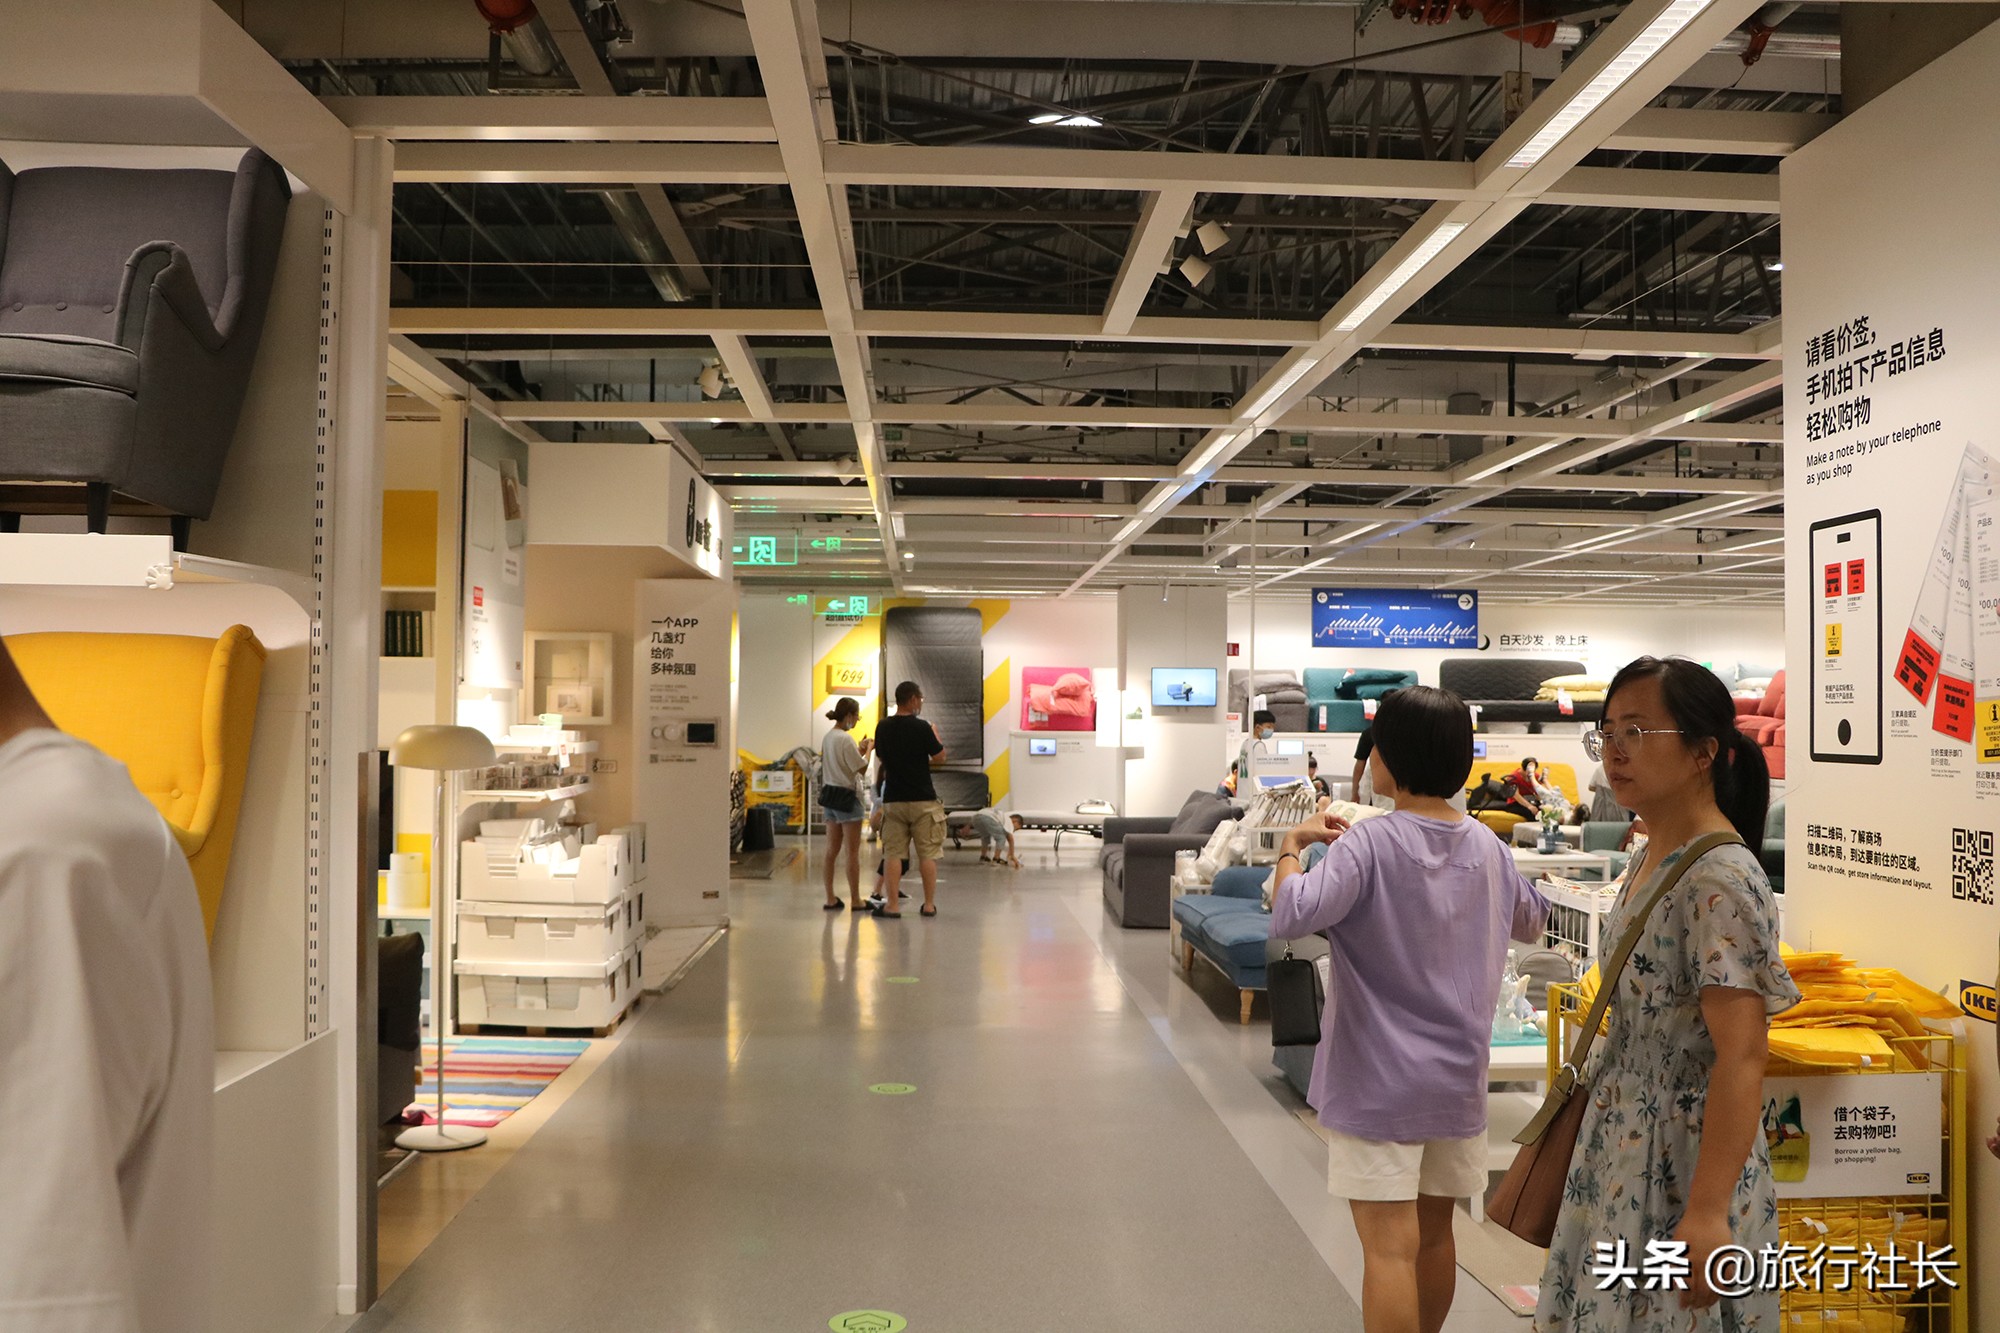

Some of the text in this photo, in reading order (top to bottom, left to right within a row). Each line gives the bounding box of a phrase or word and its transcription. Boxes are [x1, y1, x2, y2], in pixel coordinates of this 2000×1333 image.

[1806, 315, 1876, 368] 请看价签，
[1806, 328, 1946, 405] 手机拍下产品信息
[1806, 395, 1871, 442] 轻松购物
[1806, 420, 1941, 467] Make a note by your telephone
[1806, 463, 1852, 485] as you shop
[651, 617, 699, 628] 一个APP
[651, 632, 686, 644] 几盏灯
[1500, 634, 1588, 646] 白天沙发，晚上床
[651, 647, 674, 659] 给你
[651, 662, 696, 675] 多种氛围
[1807, 823, 1882, 847] 扫描二维码，了解商场
[1807, 842, 1920, 872] 信息和布局，到达要前往的区域。
[1808, 862, 1932, 890] Scan the QR code, get store information and layout.
[1966, 991, 1997, 1013] IKE
[1834, 1106, 1896, 1122] 借个袋子，
[1834, 1125, 1896, 1140] 去购物吧！
[1844, 1156, 1877, 1164] shopping!
[1866, 1147, 1886, 1155] yellow
